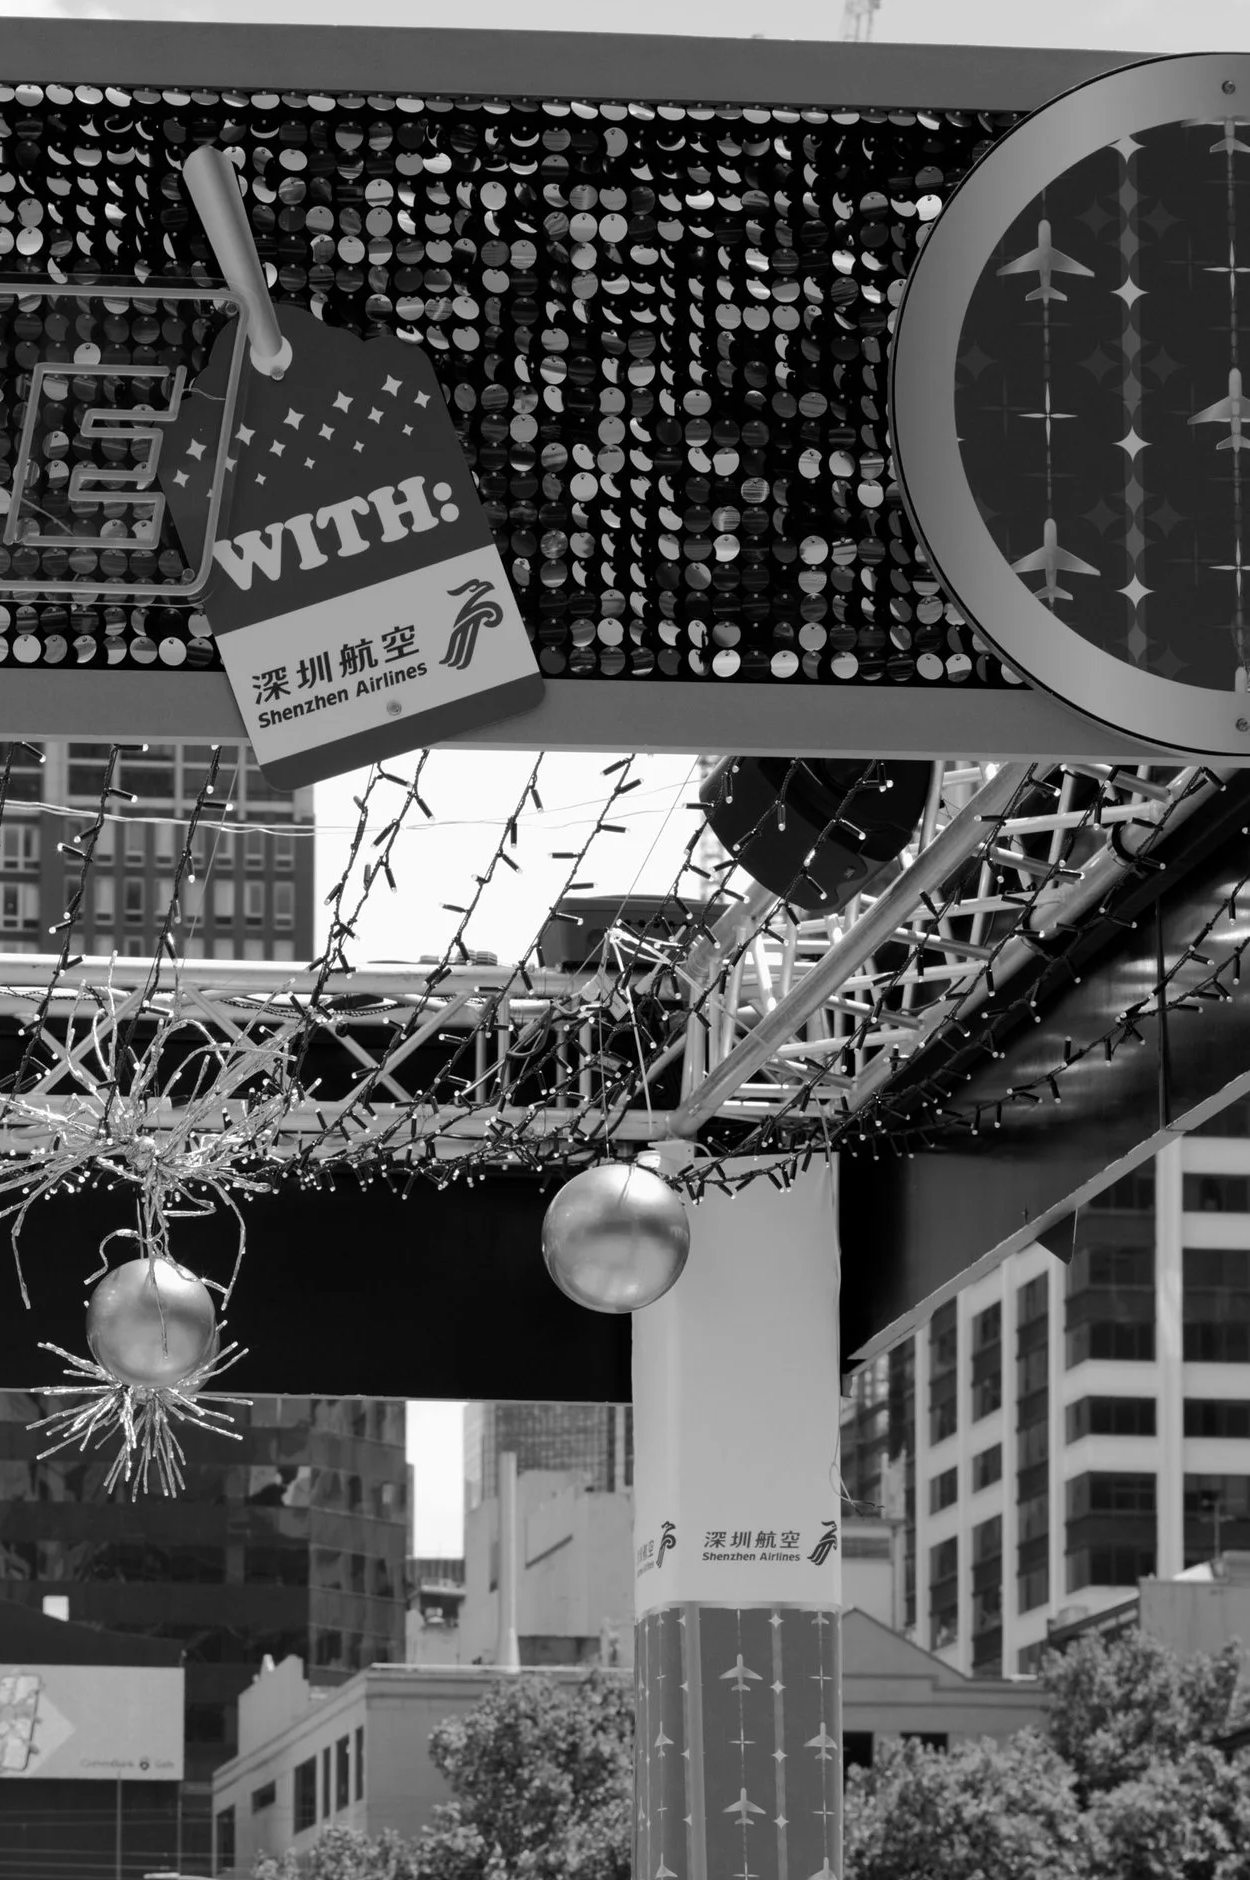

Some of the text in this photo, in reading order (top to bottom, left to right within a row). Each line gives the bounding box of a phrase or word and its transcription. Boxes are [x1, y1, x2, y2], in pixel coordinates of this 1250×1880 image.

[213, 473, 460, 592] WITH:
[250, 624, 421, 706] 深圳航空
[257, 659, 428, 728] Shenzhen Airlines
[702, 1552, 801, 1562] Shenzhen Airlines
[703, 1529, 801, 1549] 深圳航空
